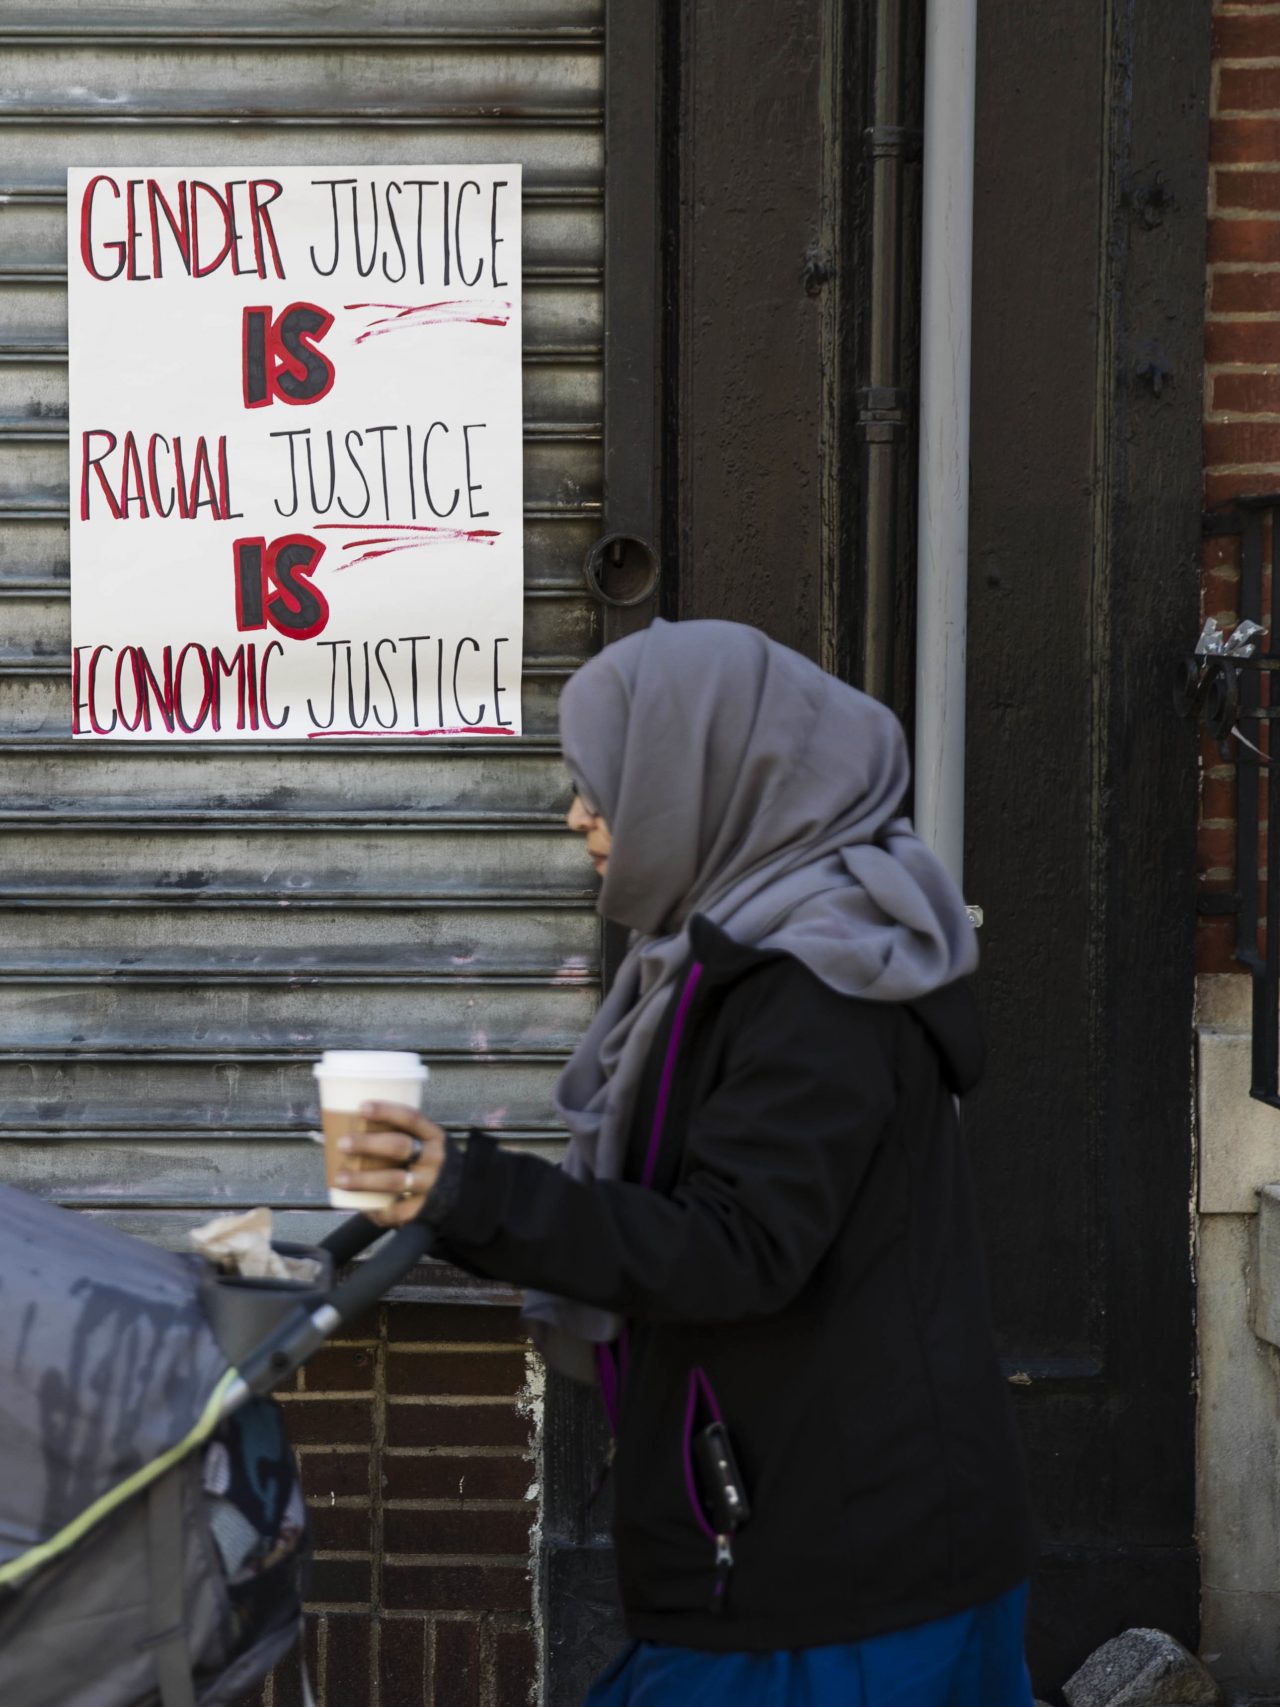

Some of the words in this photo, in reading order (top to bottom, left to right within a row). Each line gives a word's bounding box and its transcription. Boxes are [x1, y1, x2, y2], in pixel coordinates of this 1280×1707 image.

[80, 174, 286, 282] GENDER
[309, 178, 509, 288] JUSTICE
[242, 301, 336, 409] IS
[81, 429, 244, 520] RACIAL
[270, 421, 490, 521] JUSTICE
[232, 533, 330, 641] IS
[72, 640, 291, 735] ECONOMIC
[307, 635, 513, 730] JUSTICE
